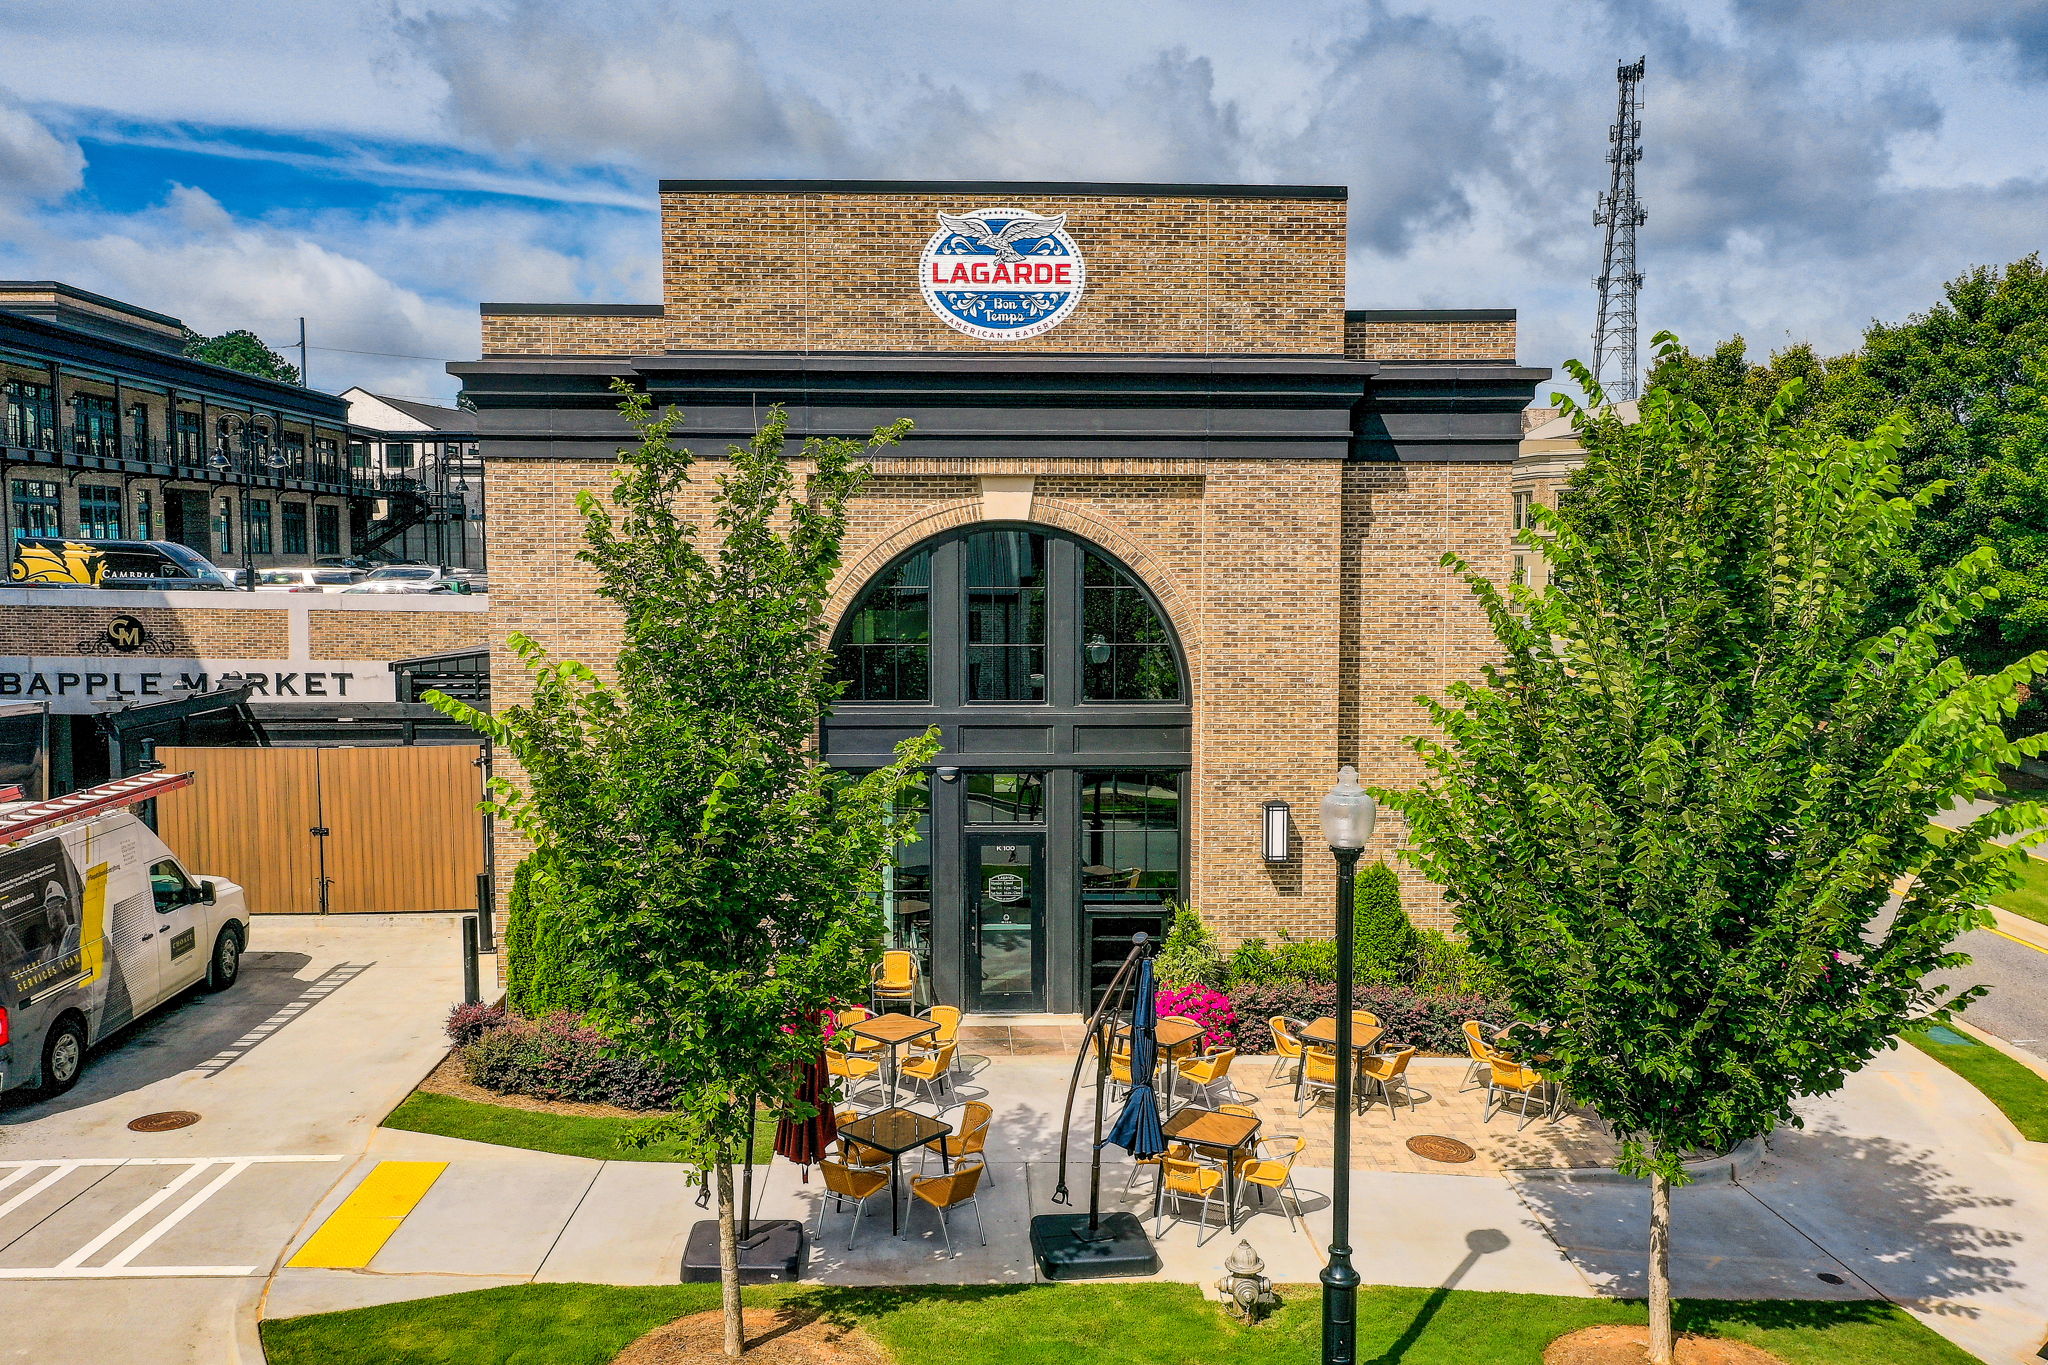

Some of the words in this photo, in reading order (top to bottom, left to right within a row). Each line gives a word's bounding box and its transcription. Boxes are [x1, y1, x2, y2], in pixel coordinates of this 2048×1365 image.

[932, 262, 1072, 285] LAGARDE
[993, 297, 1018, 310] Bon
[983, 309, 1025, 325] Temps
[947, 318, 1003, 339] AMERICAN
[1015, 319, 1056, 338] EATERY
[0, 672, 163, 696] BAPPLE
[17, 965, 57, 992] SERVICES
[60, 954, 80, 970] TEAM
